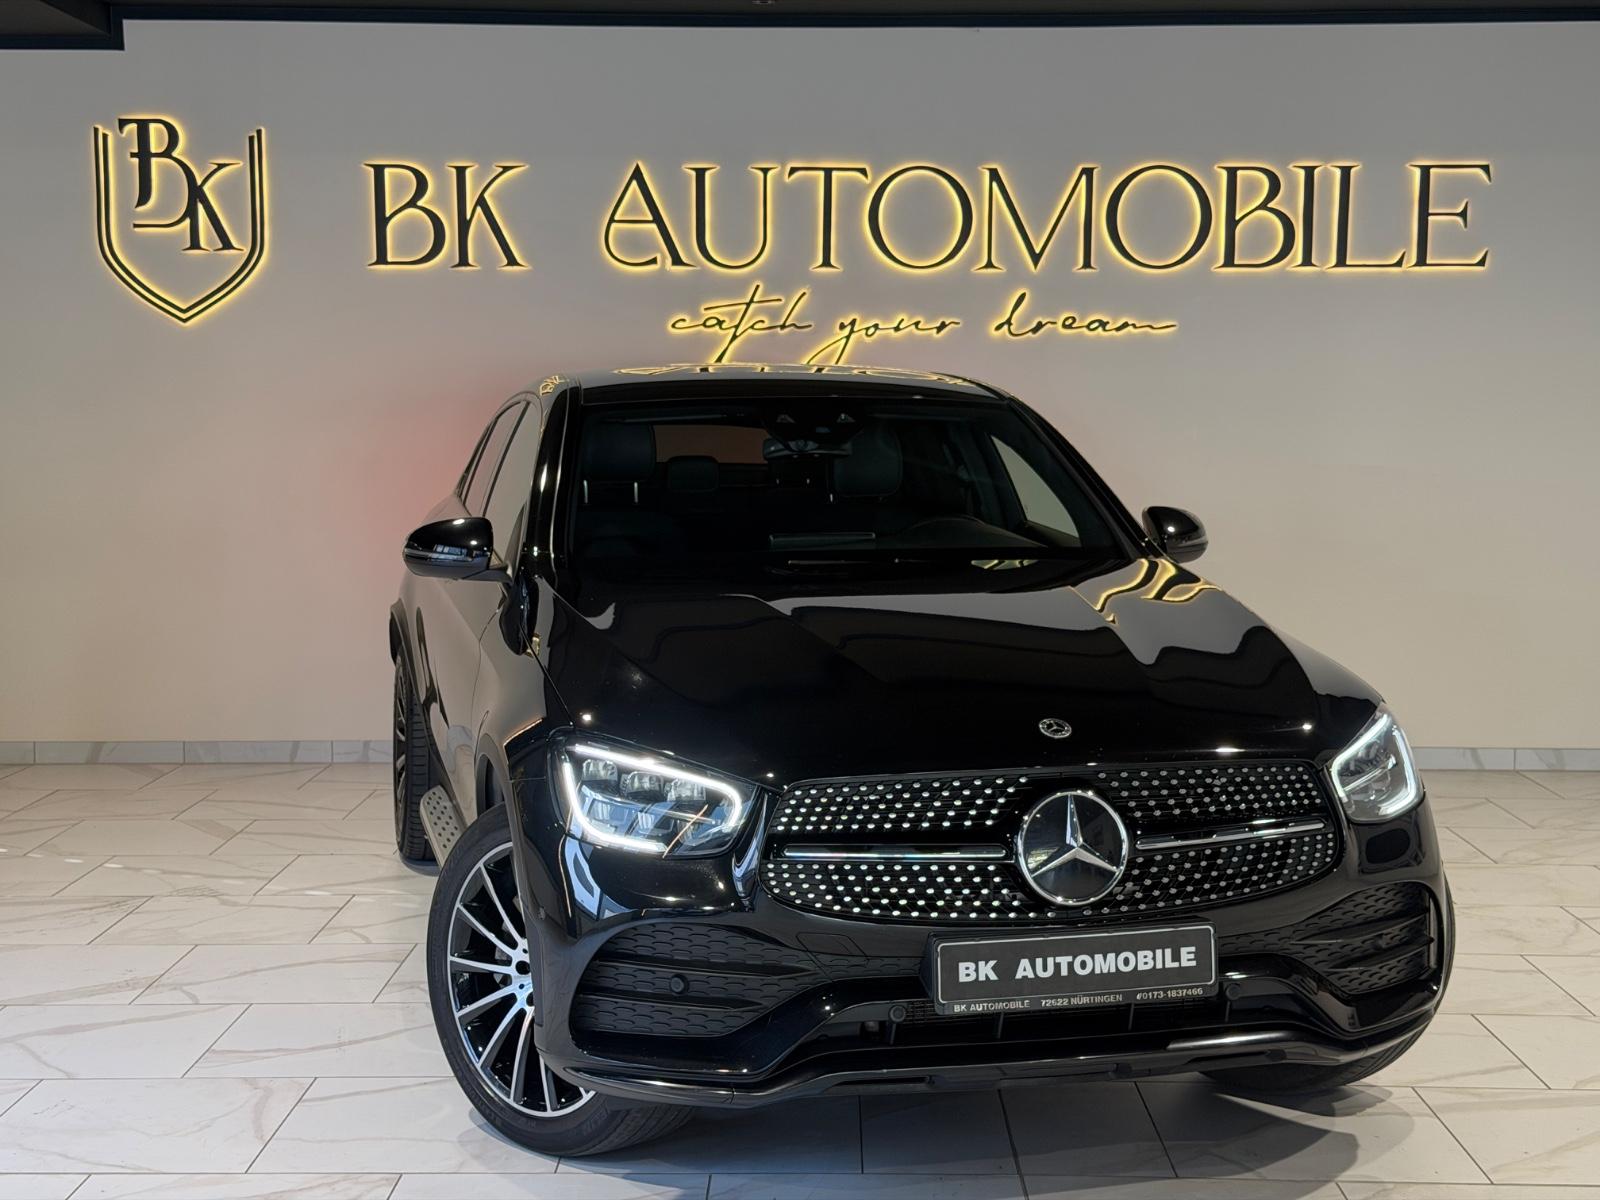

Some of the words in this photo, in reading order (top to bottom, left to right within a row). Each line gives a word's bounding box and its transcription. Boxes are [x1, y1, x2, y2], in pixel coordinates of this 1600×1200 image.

[363, 162, 529, 269] BK
[603, 160, 1492, 271] AUTOMOBILE
[669, 283, 813, 364] catch
[805, 315, 961, 365] your
[993, 290, 1178, 337] dream
[957, 960, 999, 983] BK
[1014, 946, 1197, 980] AUTOMOBILE
[953, 1003, 967, 1012] BK
[969, 1000, 1031, 1011] AUTOMOBILE
[1070, 994, 1123, 1006] NÜRTINGEN
